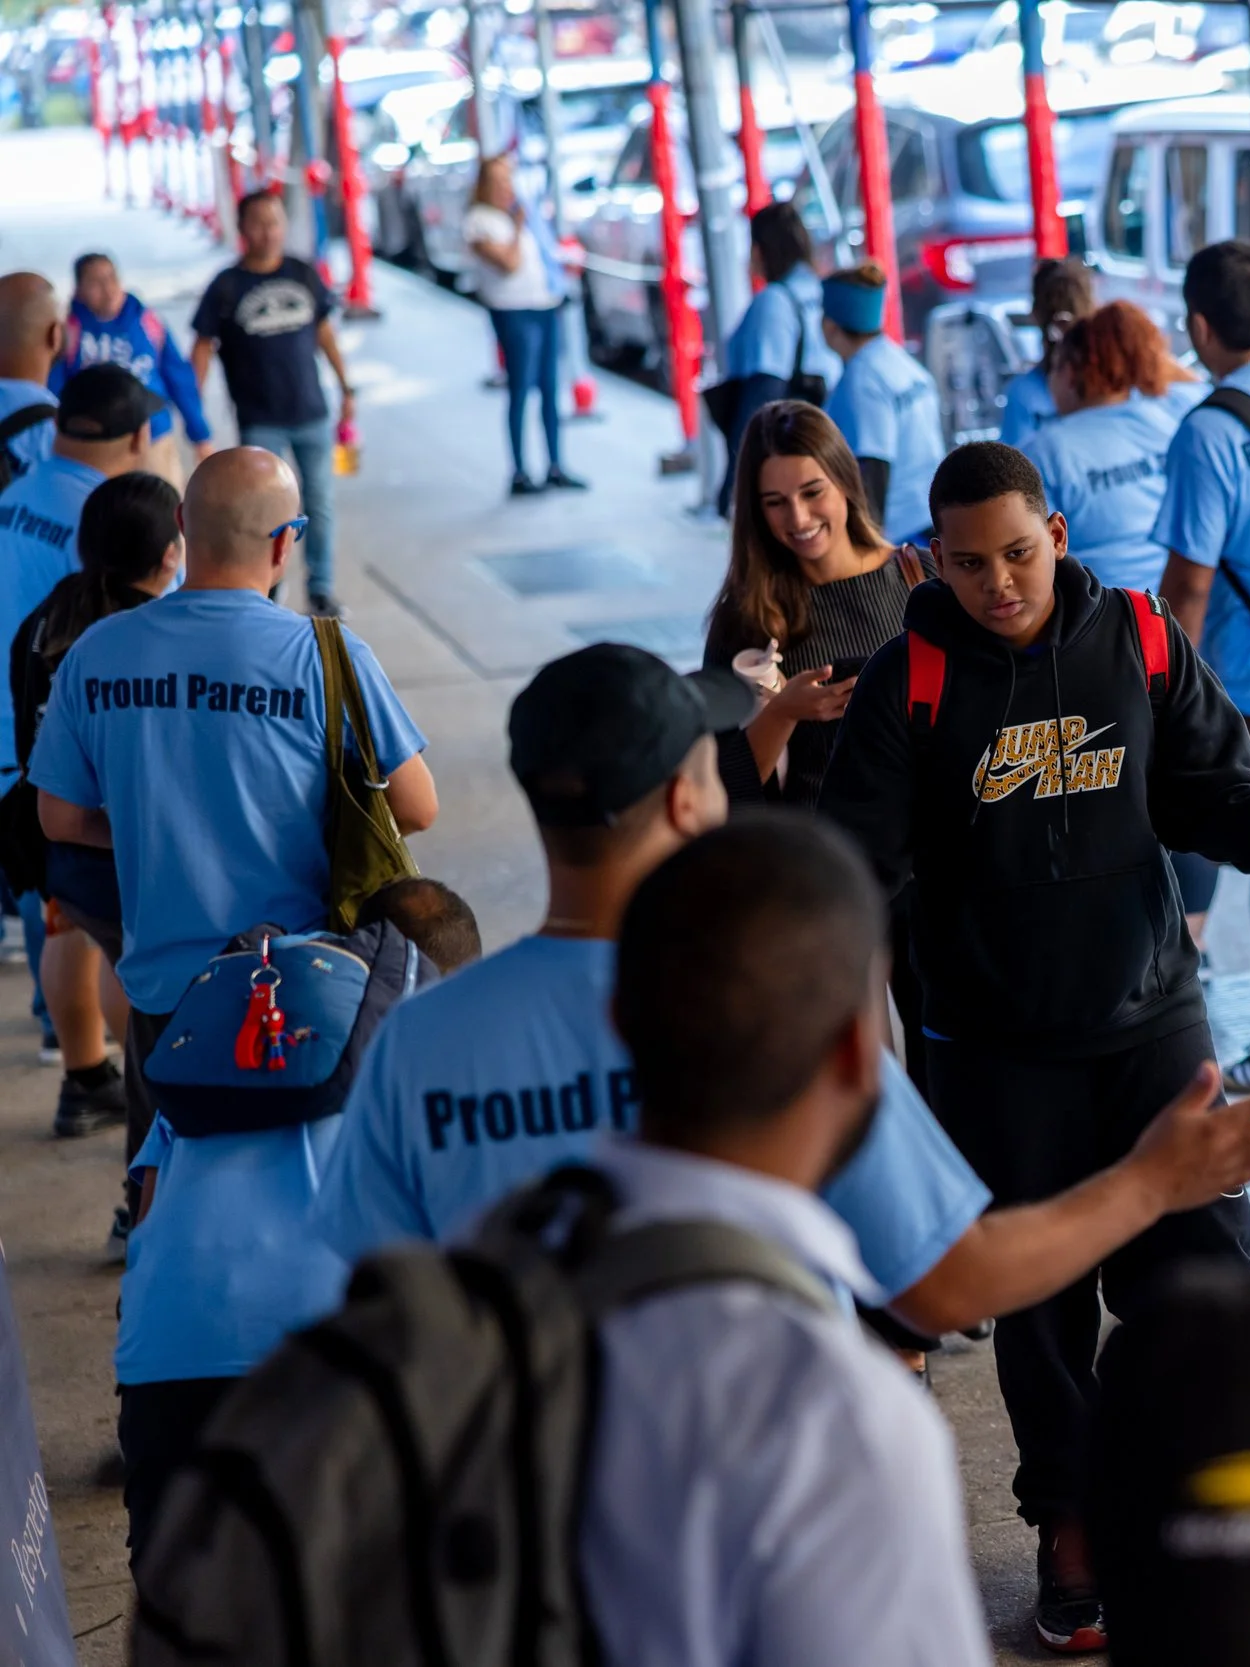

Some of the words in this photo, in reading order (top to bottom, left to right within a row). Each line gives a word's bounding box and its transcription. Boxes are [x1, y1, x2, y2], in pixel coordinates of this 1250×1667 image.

[85, 673, 177, 714] Proud
[187, 674, 306, 720] Parent
[423, 1071, 596, 1151] Proud
[12, 1472, 48, 1613] Respeto
